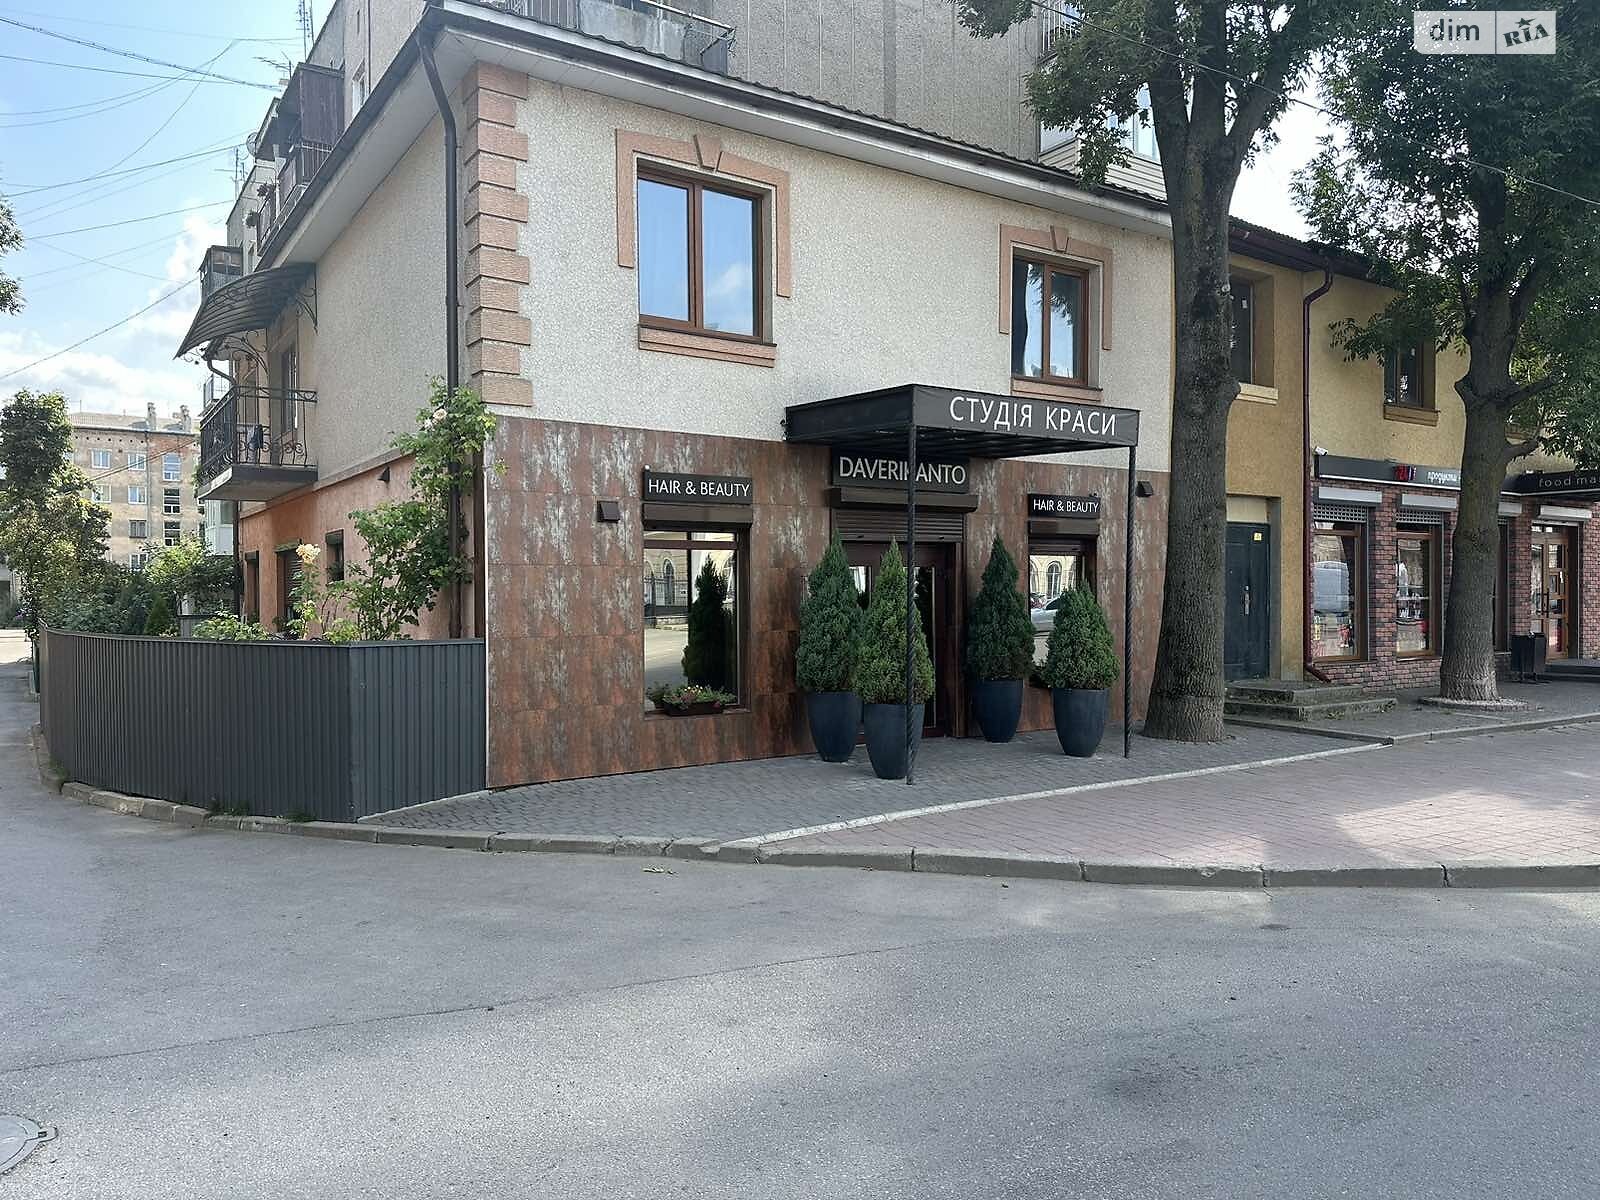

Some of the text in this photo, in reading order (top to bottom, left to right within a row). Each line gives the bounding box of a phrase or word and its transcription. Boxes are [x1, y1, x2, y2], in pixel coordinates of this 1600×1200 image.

[949, 396, 1117, 436] СТУДІЯ КРАСИ
[648, 479, 750, 497] HAIR & BEAUTY
[1538, 474, 1600, 488] food ma
[1033, 499, 1099, 513] HAIR & BEAUTY
